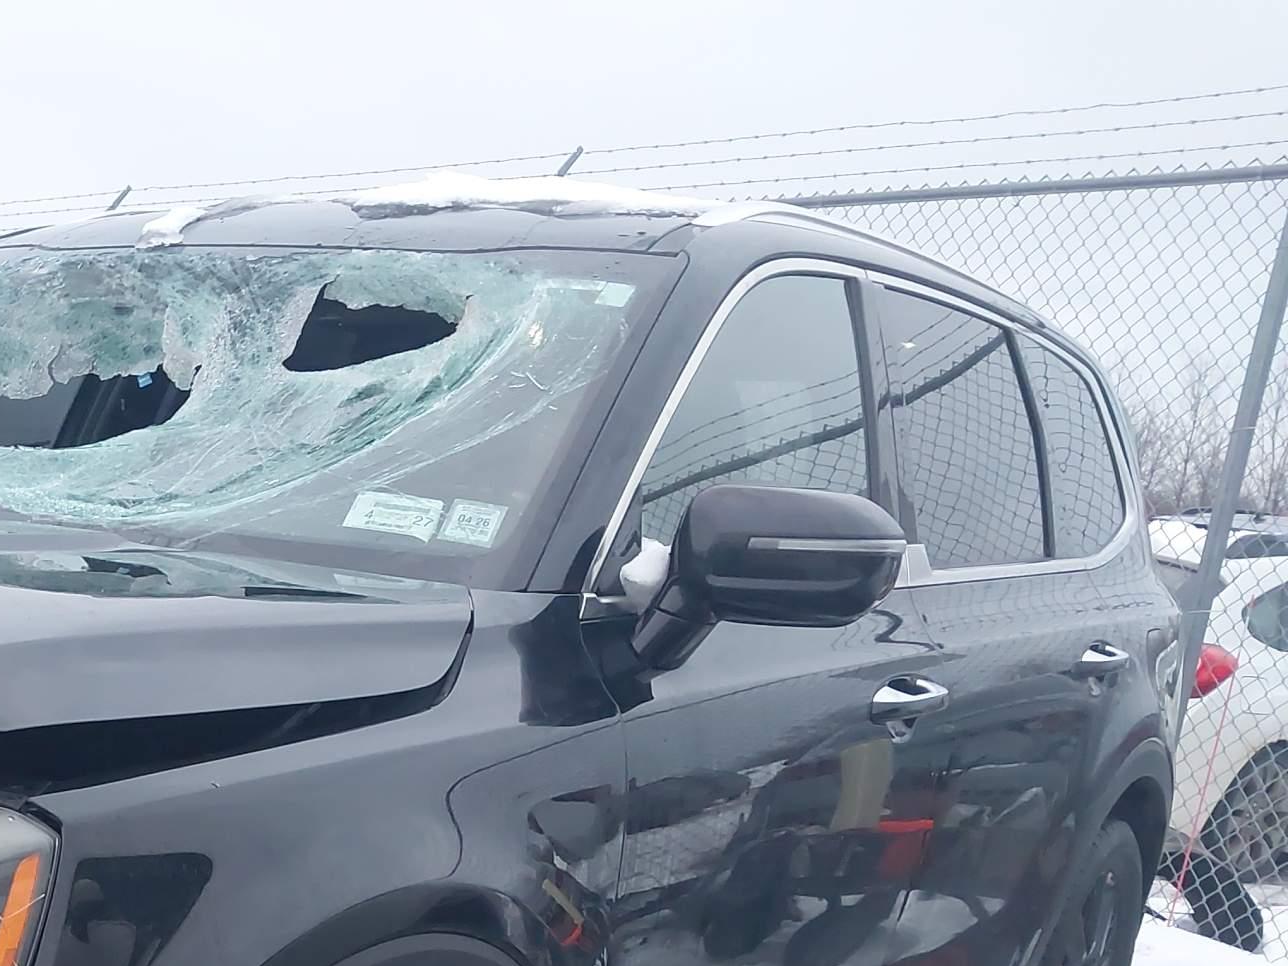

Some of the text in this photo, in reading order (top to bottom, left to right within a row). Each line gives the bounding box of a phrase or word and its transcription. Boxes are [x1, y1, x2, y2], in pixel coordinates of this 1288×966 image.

[364, 509, 374, 519] 4
[412, 515, 434, 528] 27
[457, 514, 490, 527] 04 26
